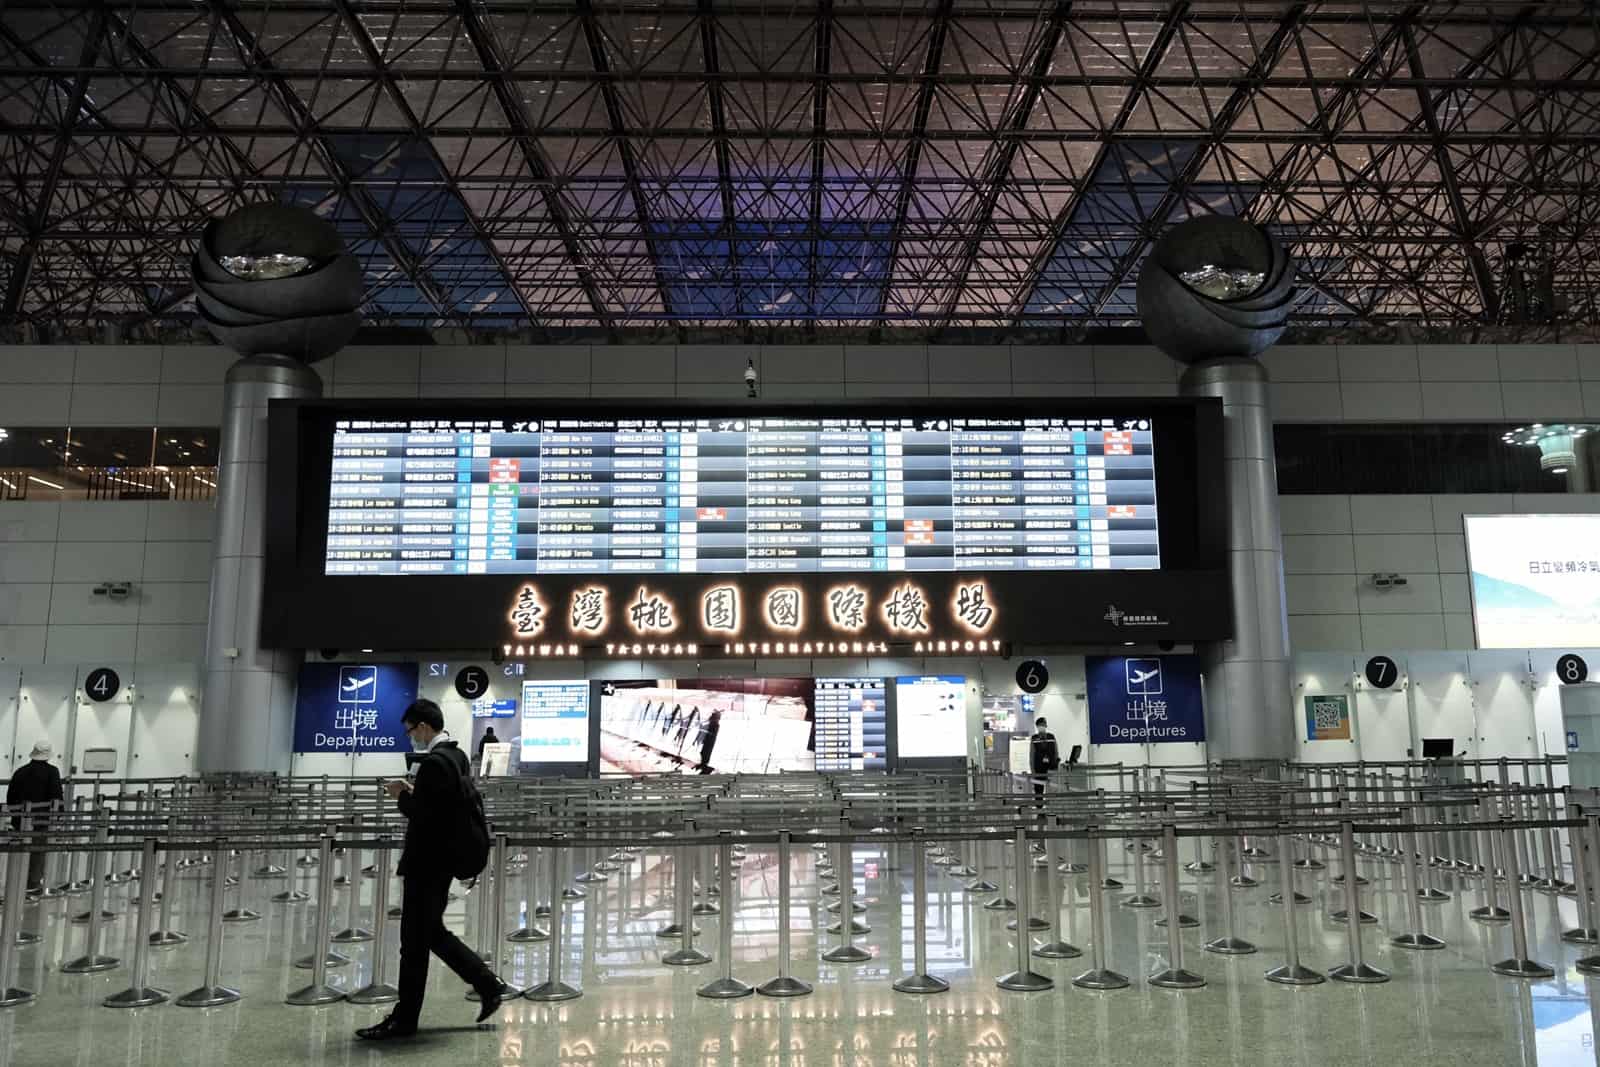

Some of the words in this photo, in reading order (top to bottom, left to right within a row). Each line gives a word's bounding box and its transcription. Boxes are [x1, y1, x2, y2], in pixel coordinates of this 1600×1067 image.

[511, 583, 995, 633] 臺灣桃園國際機場
[503, 644, 579, 656] TAIWAN
[606, 643, 698, 655] TAOYUAN
[724, 641, 889, 655] INTERNATIONAL
[914, 640, 1001, 653] AIRPORT
[1026, 670, 1040, 687] 6
[1375, 662, 1387, 682] 7
[1565, 659, 1580, 680] 8
[93, 674, 109, 695] 4
[466, 672, 479, 693] 5
[335, 708, 379, 730] 出境
[1126, 700, 1168, 720] 出境
[315, 732, 396, 750] Departures
[1109, 724, 1187, 741] Departures
